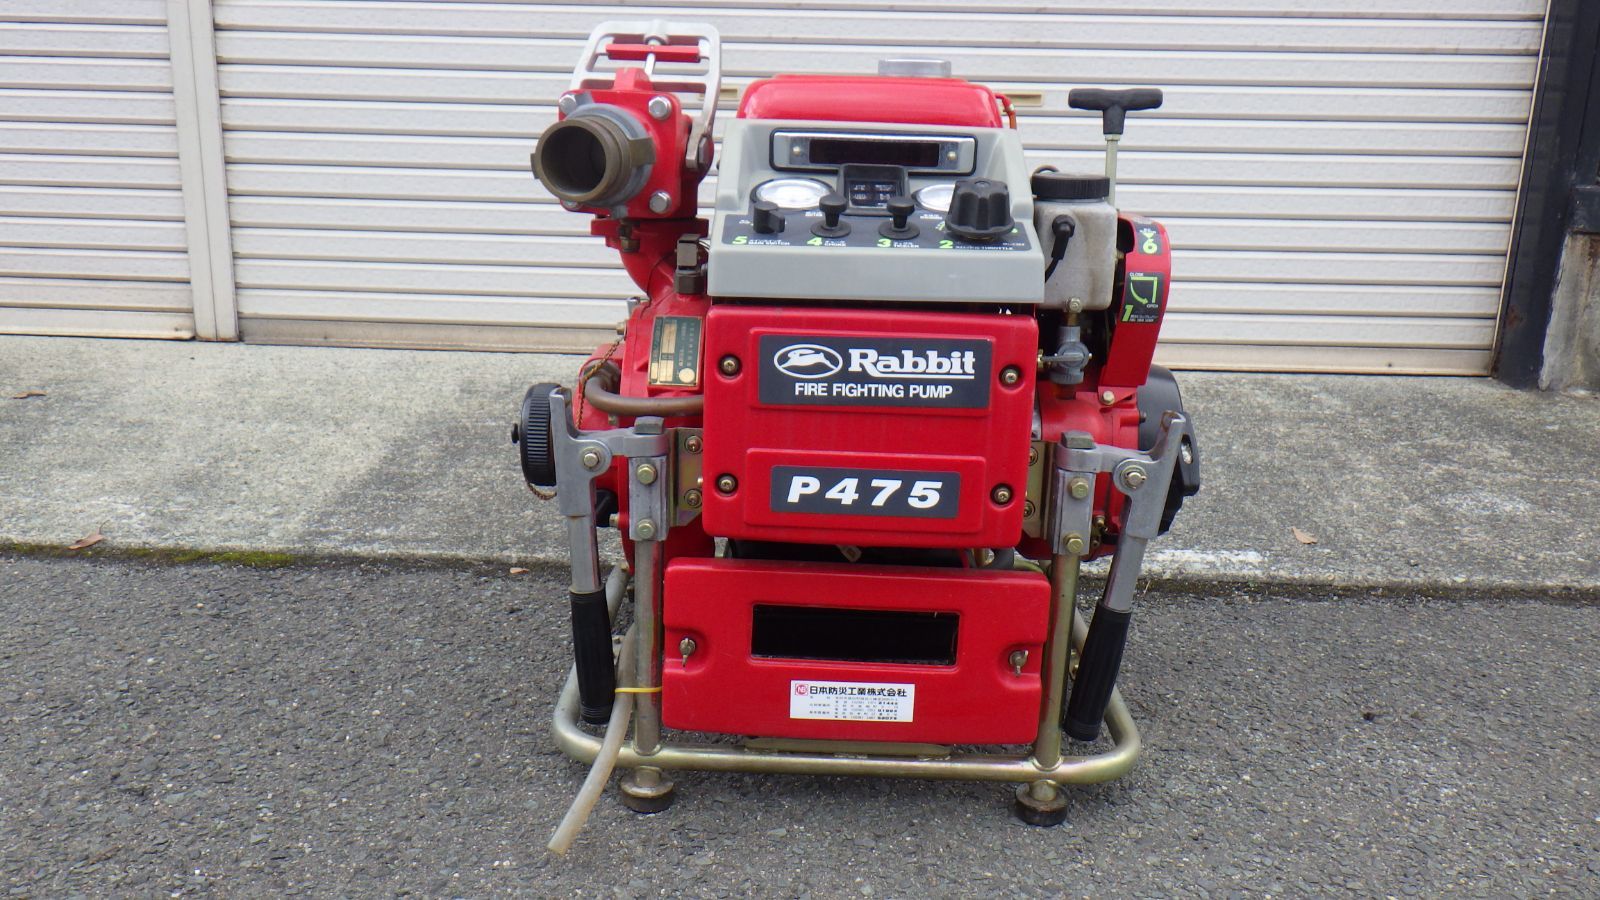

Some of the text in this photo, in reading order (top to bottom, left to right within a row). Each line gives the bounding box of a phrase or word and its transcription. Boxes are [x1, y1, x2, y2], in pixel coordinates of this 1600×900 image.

[732, 236, 748, 245] 5
[807, 237, 823, 245] 4
[877, 238, 891, 247] 3
[939, 239, 954, 249] 2
[1143, 238, 1158, 254] 6
[1121, 304, 1134, 321] 1
[848, 348, 975, 379] Rabbit
[794, 382, 954, 399] FIRE FIGHTING PUMP
[787, 475, 943, 509] P475
[809, 685, 908, 697] 日本防災工業株式会社
